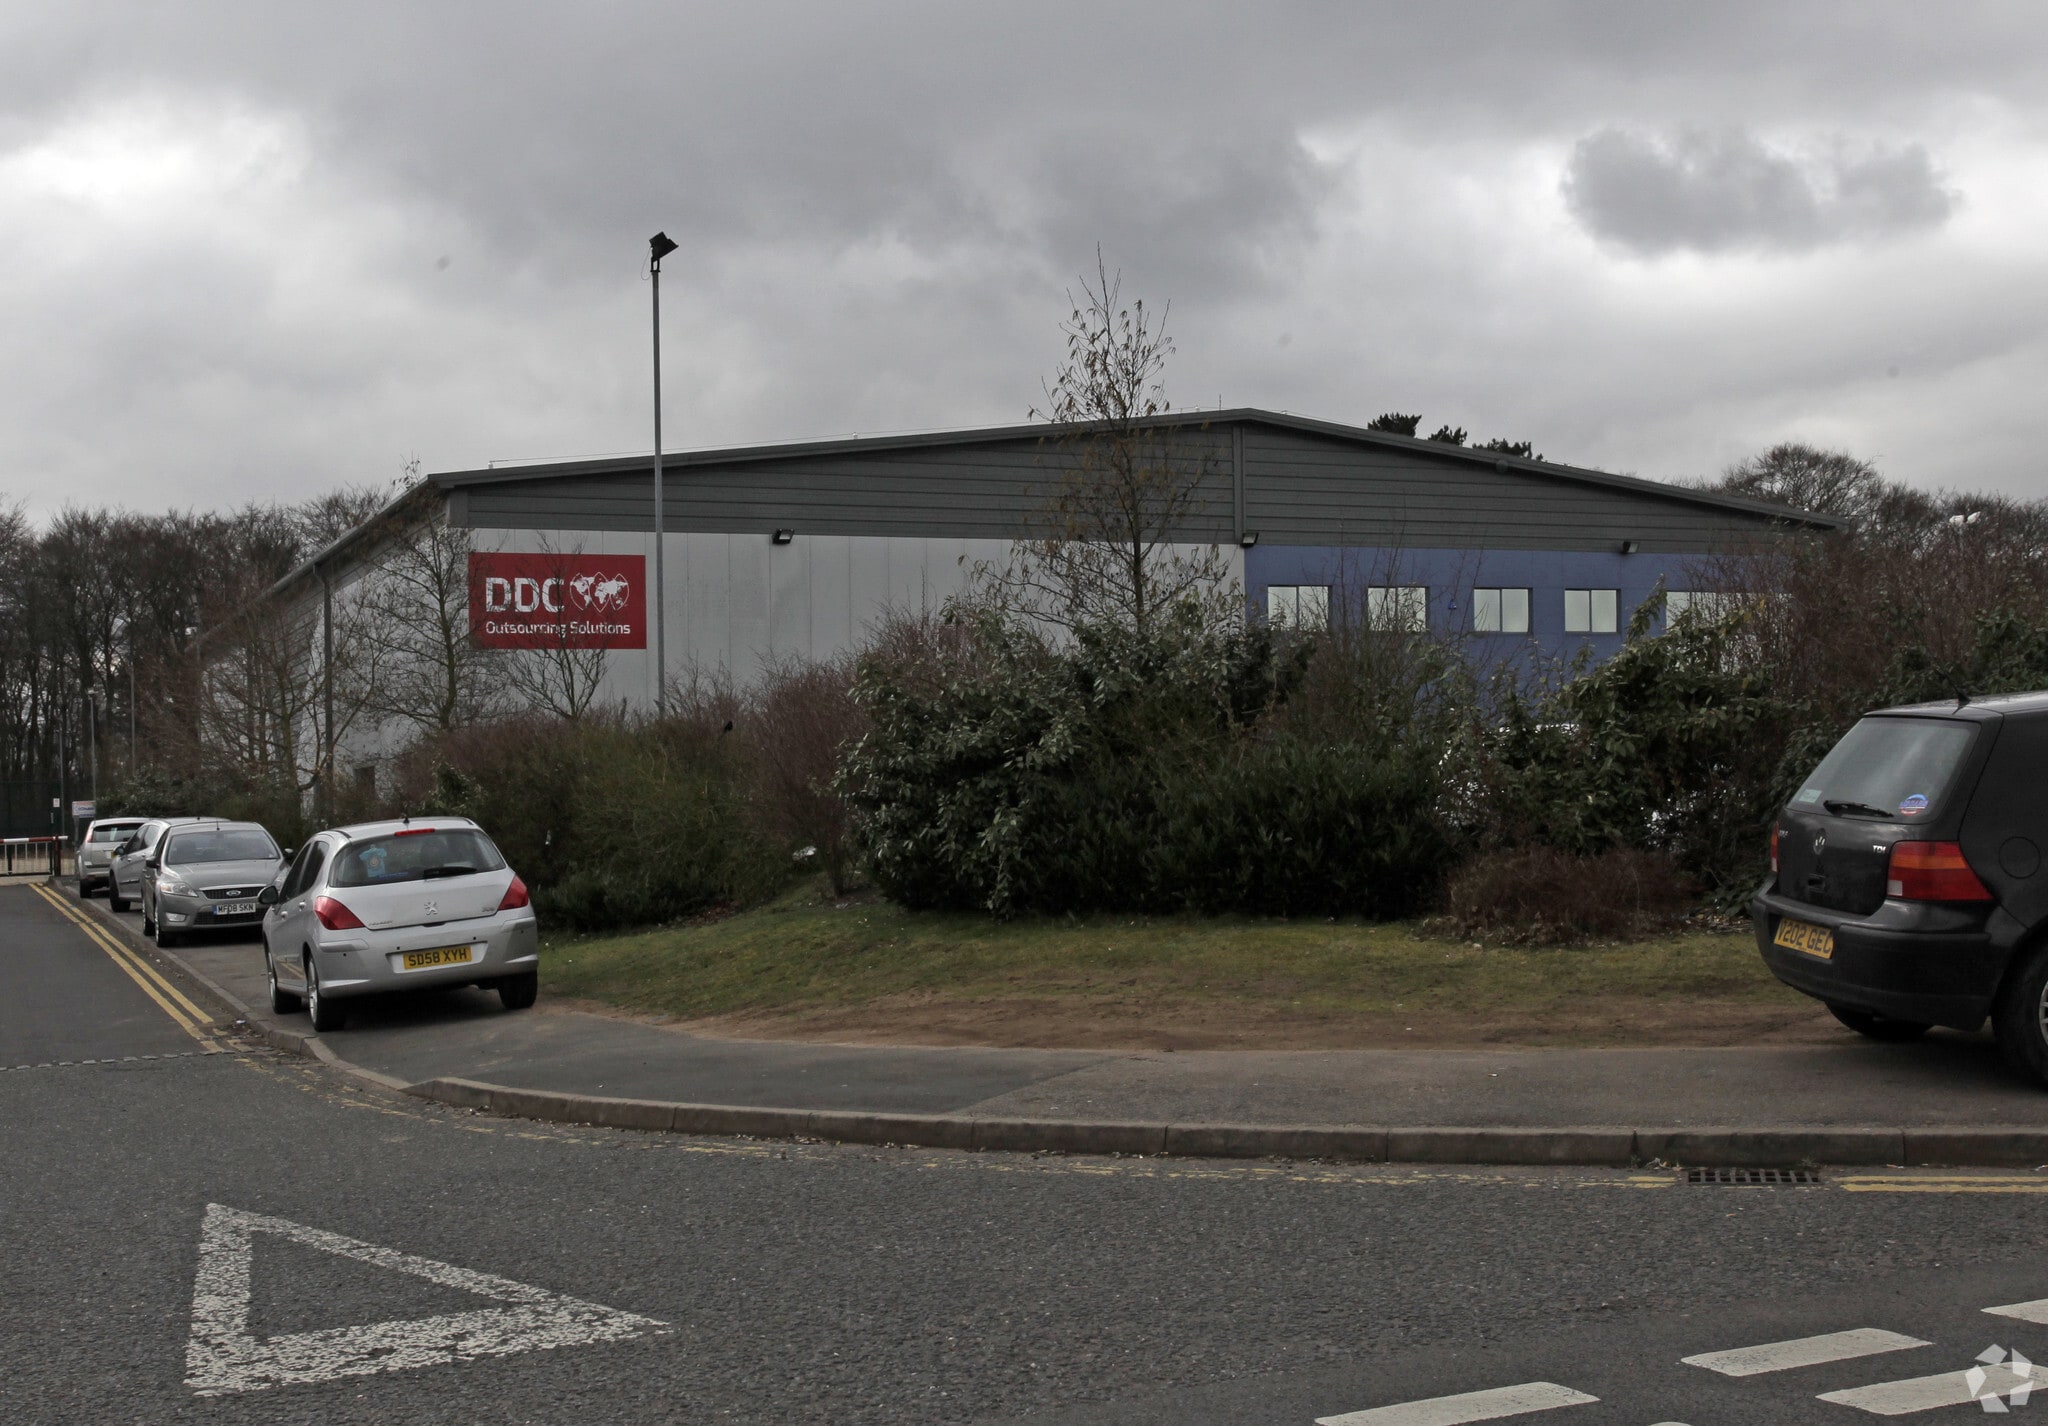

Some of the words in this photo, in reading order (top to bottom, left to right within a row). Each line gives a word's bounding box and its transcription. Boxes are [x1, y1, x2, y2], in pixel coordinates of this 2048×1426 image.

[485, 577, 565, 613] DDC
[485, 620, 567, 638] Outsourcing
[570, 621, 631, 635] Solutions
[408, 952, 441, 967] SD58
[443, 948, 468, 962] XYH
